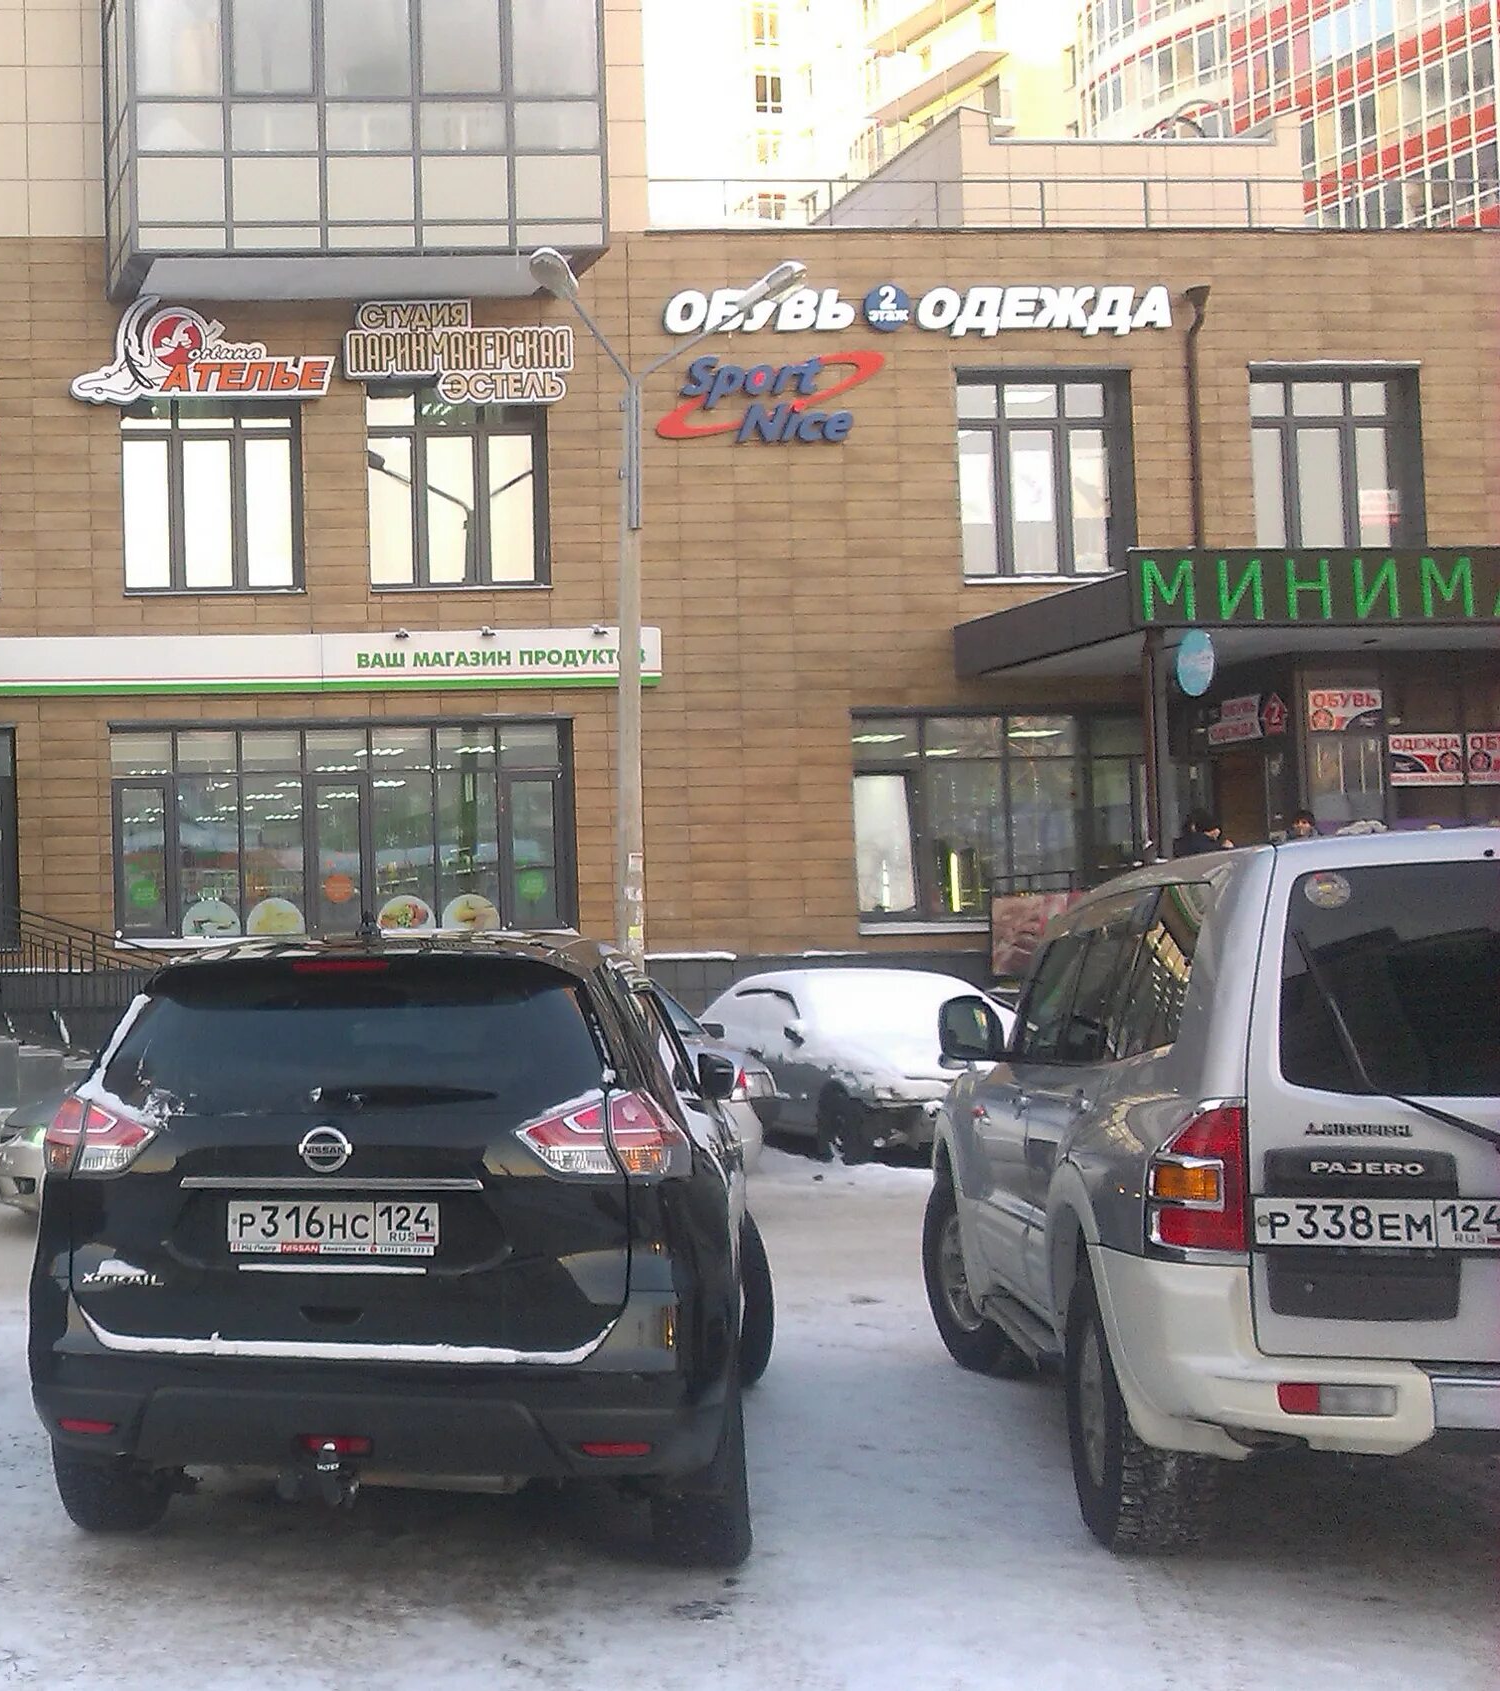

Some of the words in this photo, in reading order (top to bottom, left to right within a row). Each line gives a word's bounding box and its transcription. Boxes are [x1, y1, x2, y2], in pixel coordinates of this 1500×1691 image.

[663, 287, 856, 335] ОБУВЬ
[878, 285, 897, 310] 2
[916, 285, 1173, 337] ОДЕЖДА
[360, 302, 469, 331] СТУДИЯ
[348, 329, 572, 372] ПАРИКМАХЕРСКАЯ
[160, 361, 329, 392] АТЕЛЬЕ
[441, 372, 563, 400] ЭСТЕЛЬ
[680, 355, 824, 410] Sport
[736, 401, 855, 443] Nice
[1141, 556, 1500, 621] МИНИМ
[356, 652, 406, 669] ВАШ
[412, 650, 511, 668] МАГАЗИН
[519, 648, 646, 669] ПРОДУКТВ
[1312, 692, 1377, 708] ОБУВЬ
[303, 1145, 346, 1155] NISSAN
[1309, 1161, 1425, 1176] PAJERO
[238, 1205, 371, 1239] Р316НС
[378, 1205, 431, 1232] 124
[389, 1232, 416, 1242] RUS
[1268, 1203, 1433, 1242] Р338ЕМ
[282, 1244, 319, 1252] NISSAN
